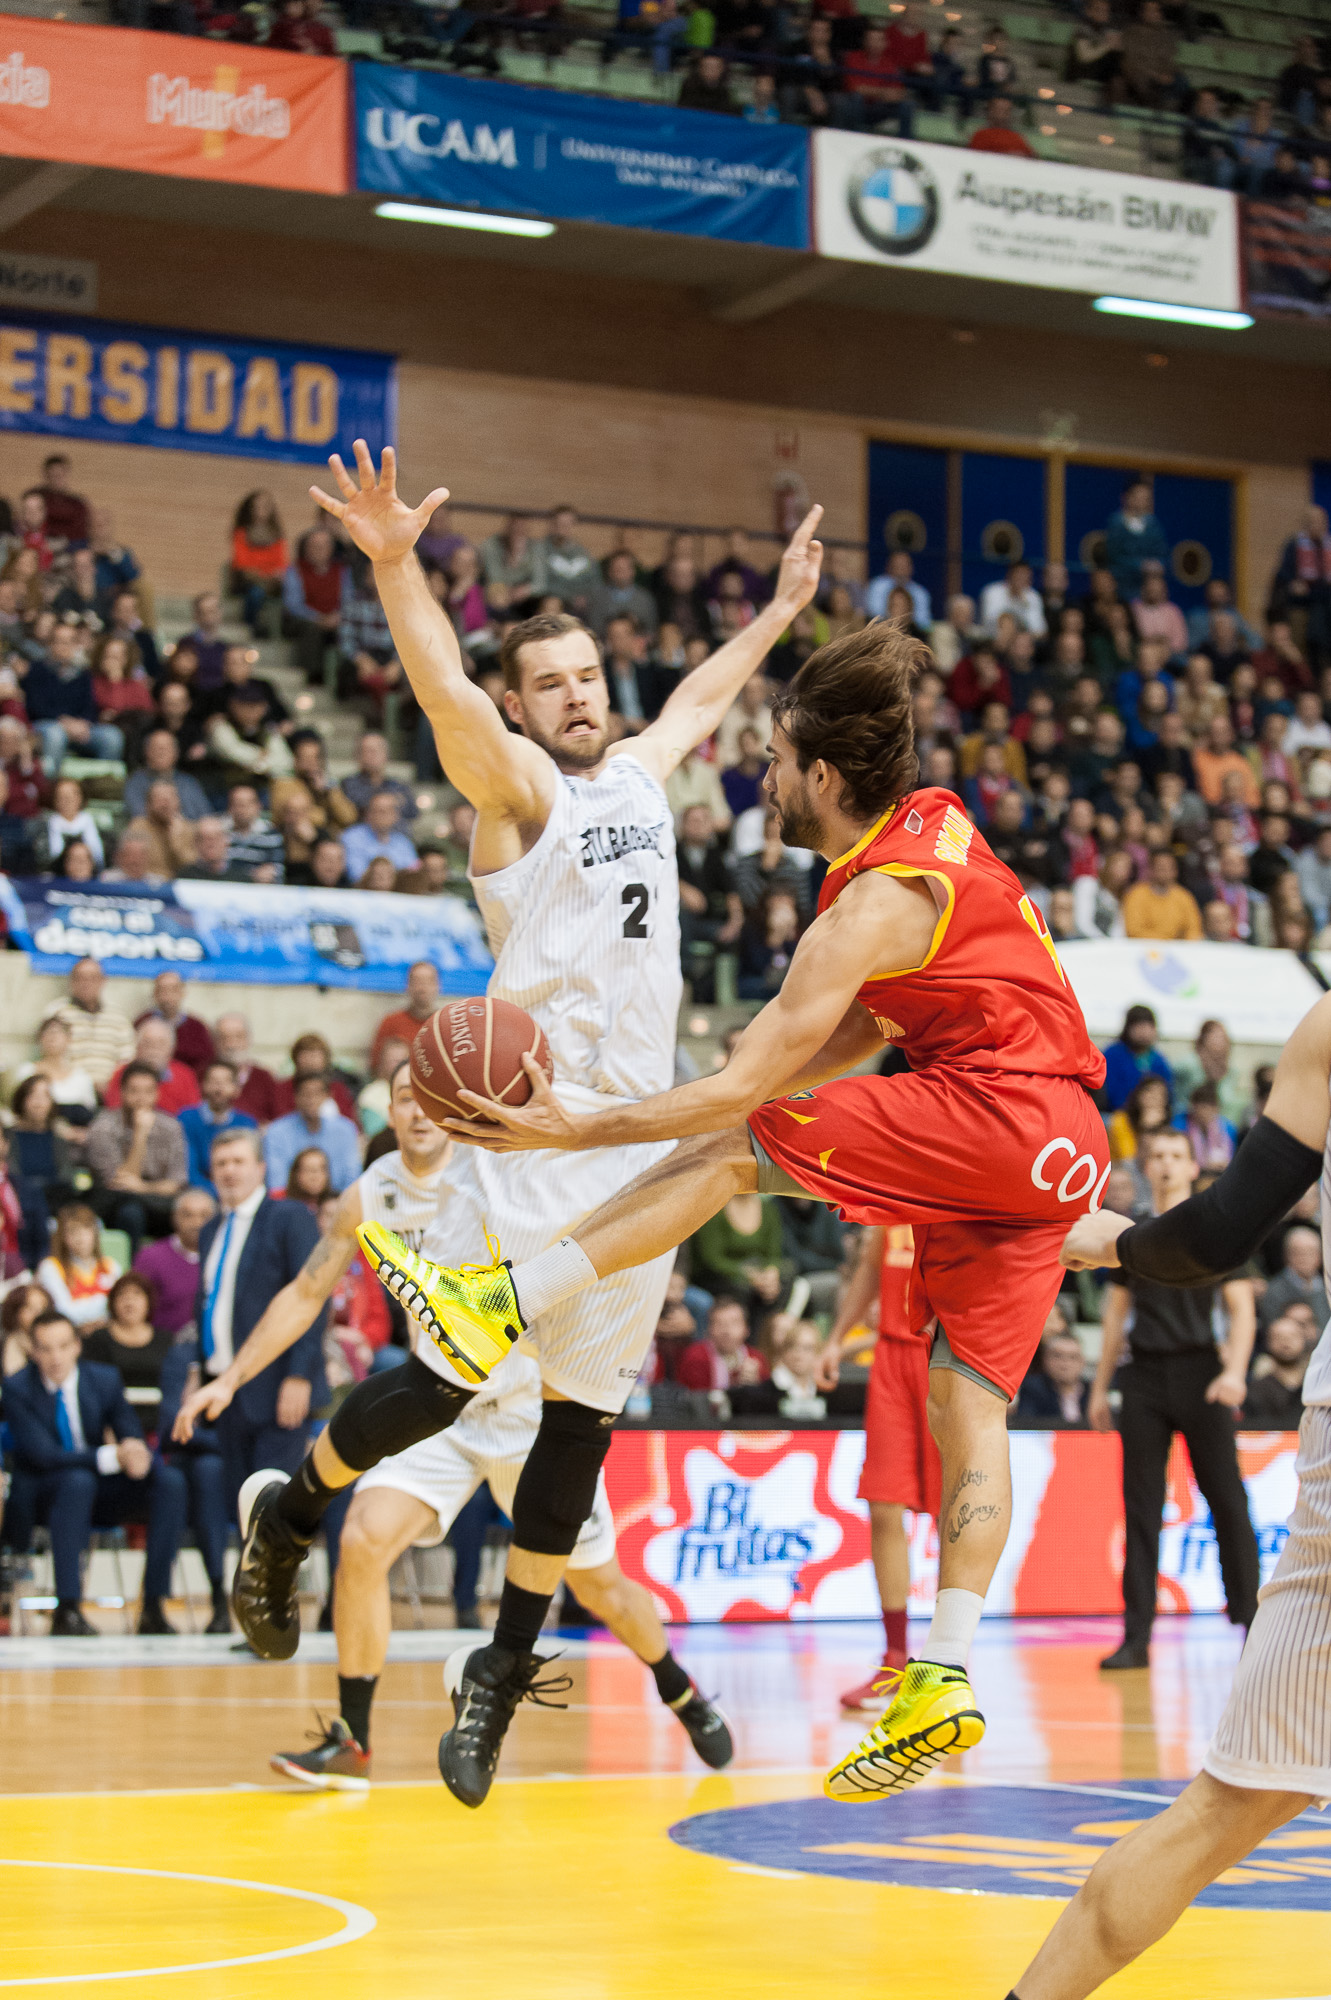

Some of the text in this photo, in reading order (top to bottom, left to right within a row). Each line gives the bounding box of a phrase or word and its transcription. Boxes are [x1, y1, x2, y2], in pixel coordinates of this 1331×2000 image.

[146, 72, 291, 139] Murcia
[365, 107, 518, 169] UCAM
[1121, 193, 1218, 238] BMW
[0, 326, 339, 447] ERSIDAD
[34, 918, 205, 963] deporte
